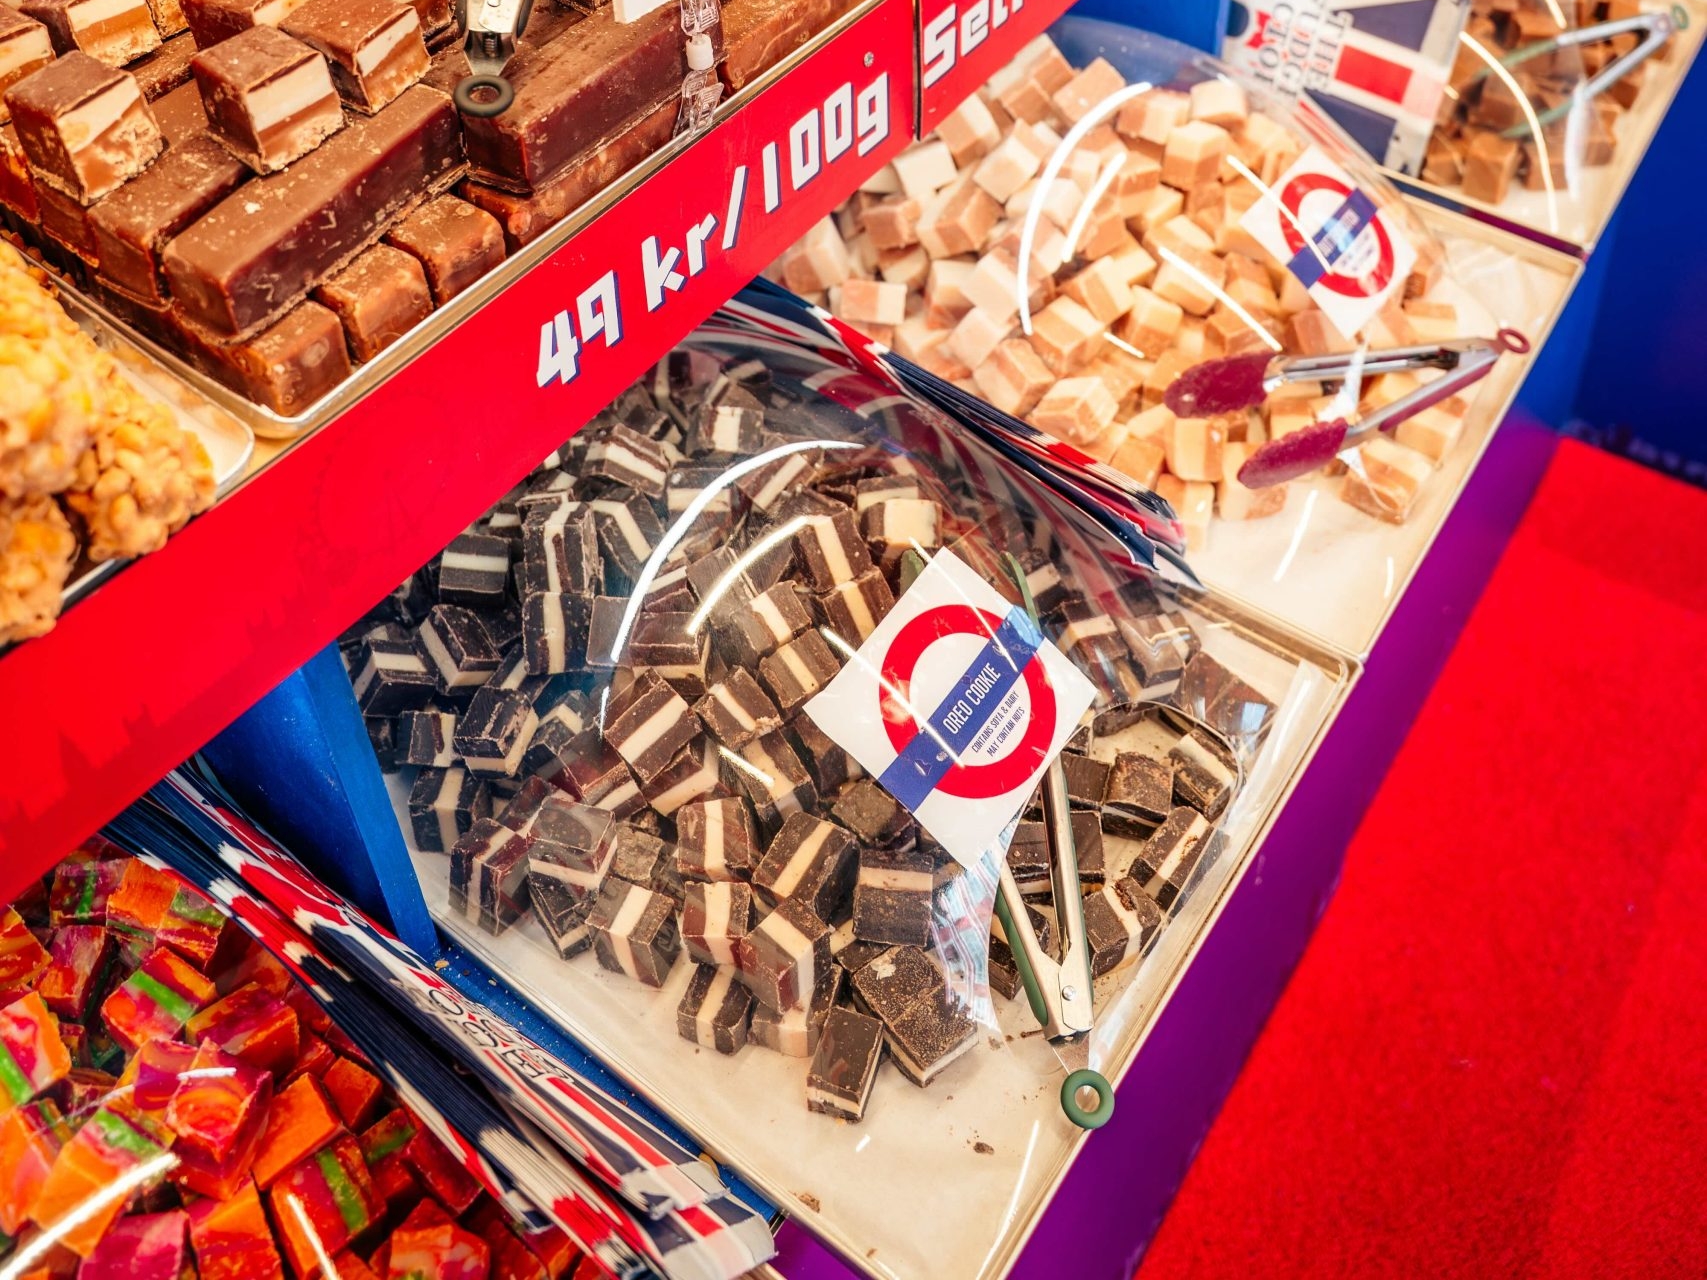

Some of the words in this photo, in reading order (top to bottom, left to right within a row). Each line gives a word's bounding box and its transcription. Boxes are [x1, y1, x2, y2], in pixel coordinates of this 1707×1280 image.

[537, 270, 623, 388] 49
[942, 699, 973, 734] OREO
[965, 662, 1001, 705] COOKIE
[1001, 706, 1009, 714] &
[1004, 690, 1020, 708] DAIRY
[986, 741, 1000, 757] MAY
[997, 720, 1016, 744] CONTAIN
[1012, 706, 1025, 723] NUTS
[990, 712, 1004, 729] SOYA
[971, 725, 994, 753] CONTAINS
